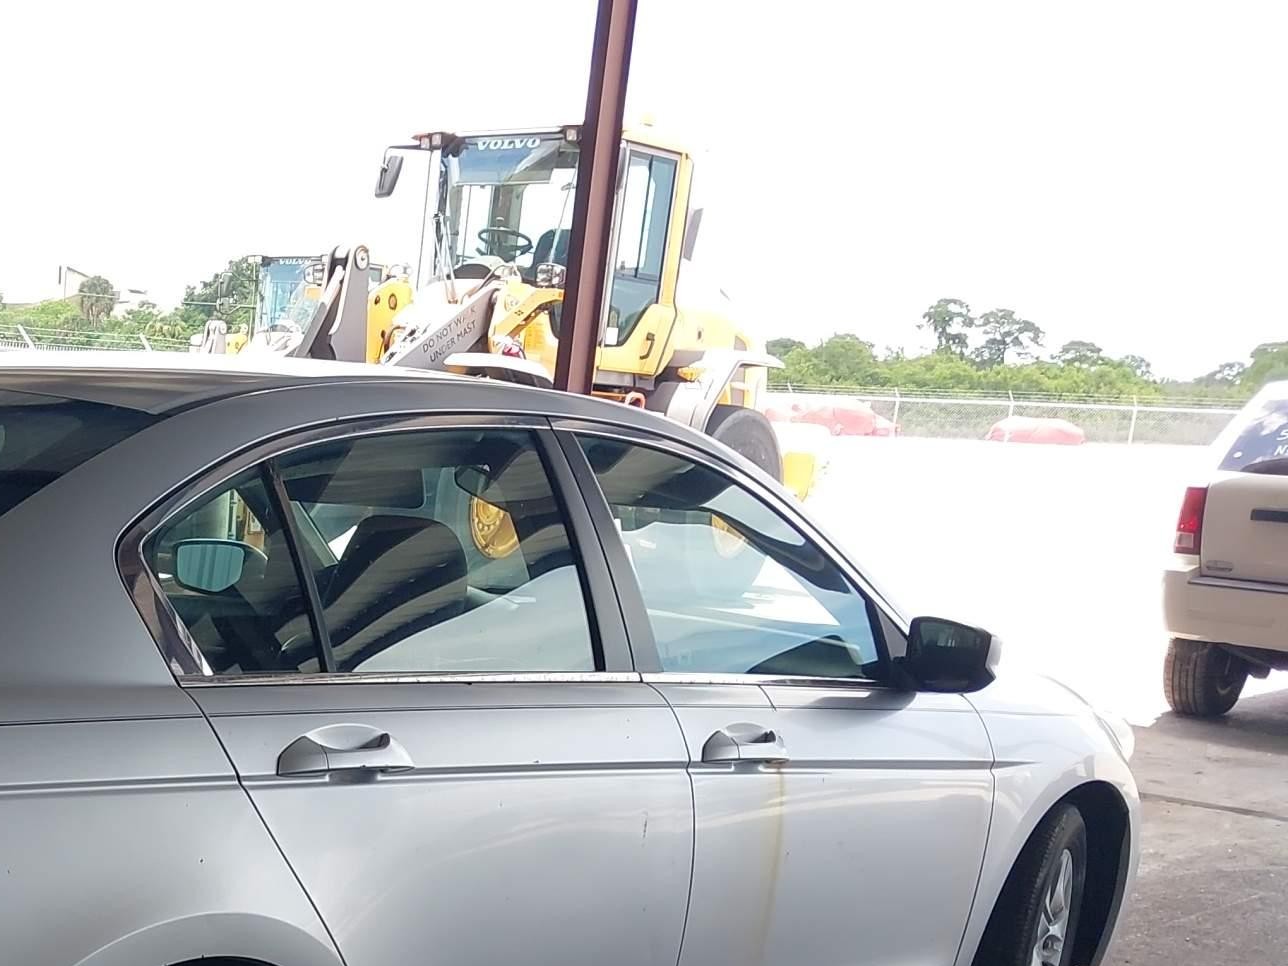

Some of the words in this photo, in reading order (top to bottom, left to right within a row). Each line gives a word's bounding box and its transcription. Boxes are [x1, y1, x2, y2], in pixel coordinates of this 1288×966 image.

[477, 137, 541, 151] VOLVO
[422, 338, 434, 352] DO
[436, 323, 453, 342] NOT
[456, 319, 476, 341] MAST
